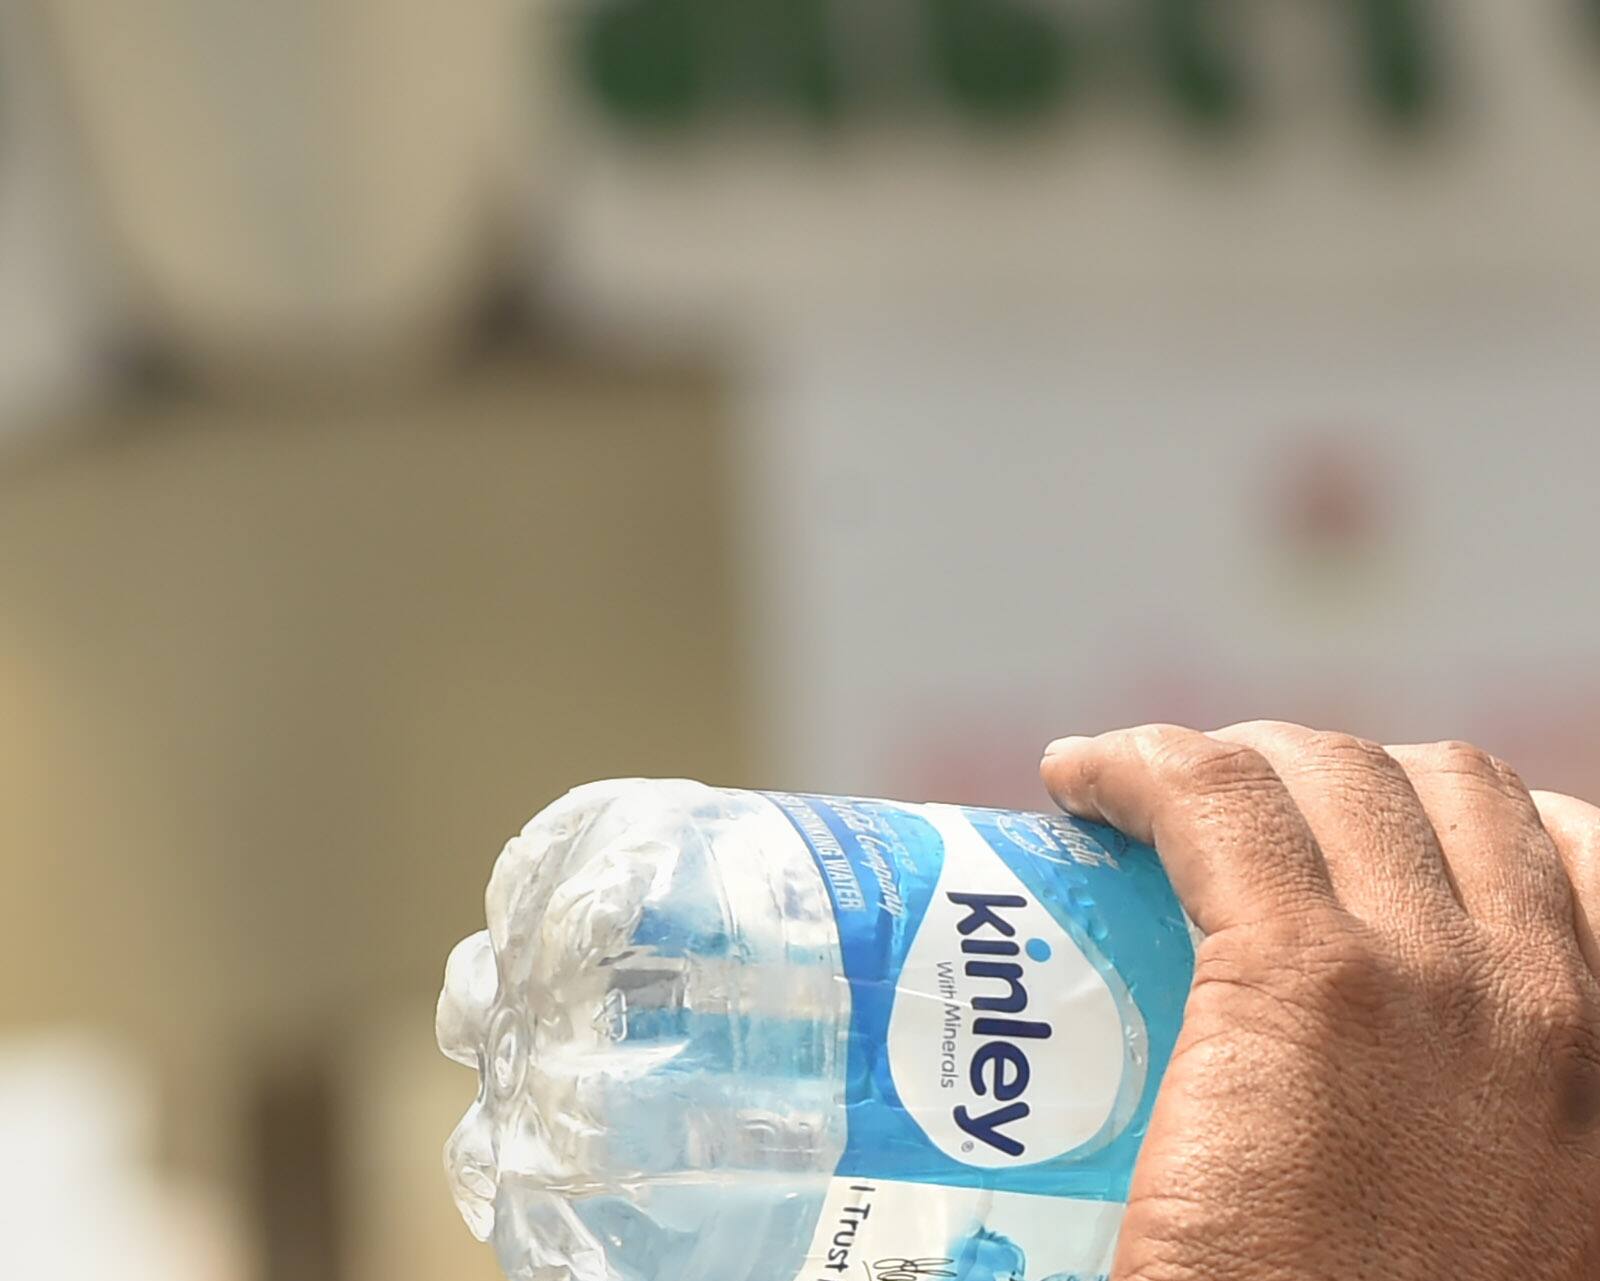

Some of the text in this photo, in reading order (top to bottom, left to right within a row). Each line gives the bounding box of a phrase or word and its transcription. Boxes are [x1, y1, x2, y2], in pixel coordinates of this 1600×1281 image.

[823, 858, 862, 908] WATER
[856, 833, 903, 918] Company
[936, 961, 962, 1089] With Minerals
[946, 891, 1052, 1157] kinley
[824, 1203, 871, 1273] Trust
